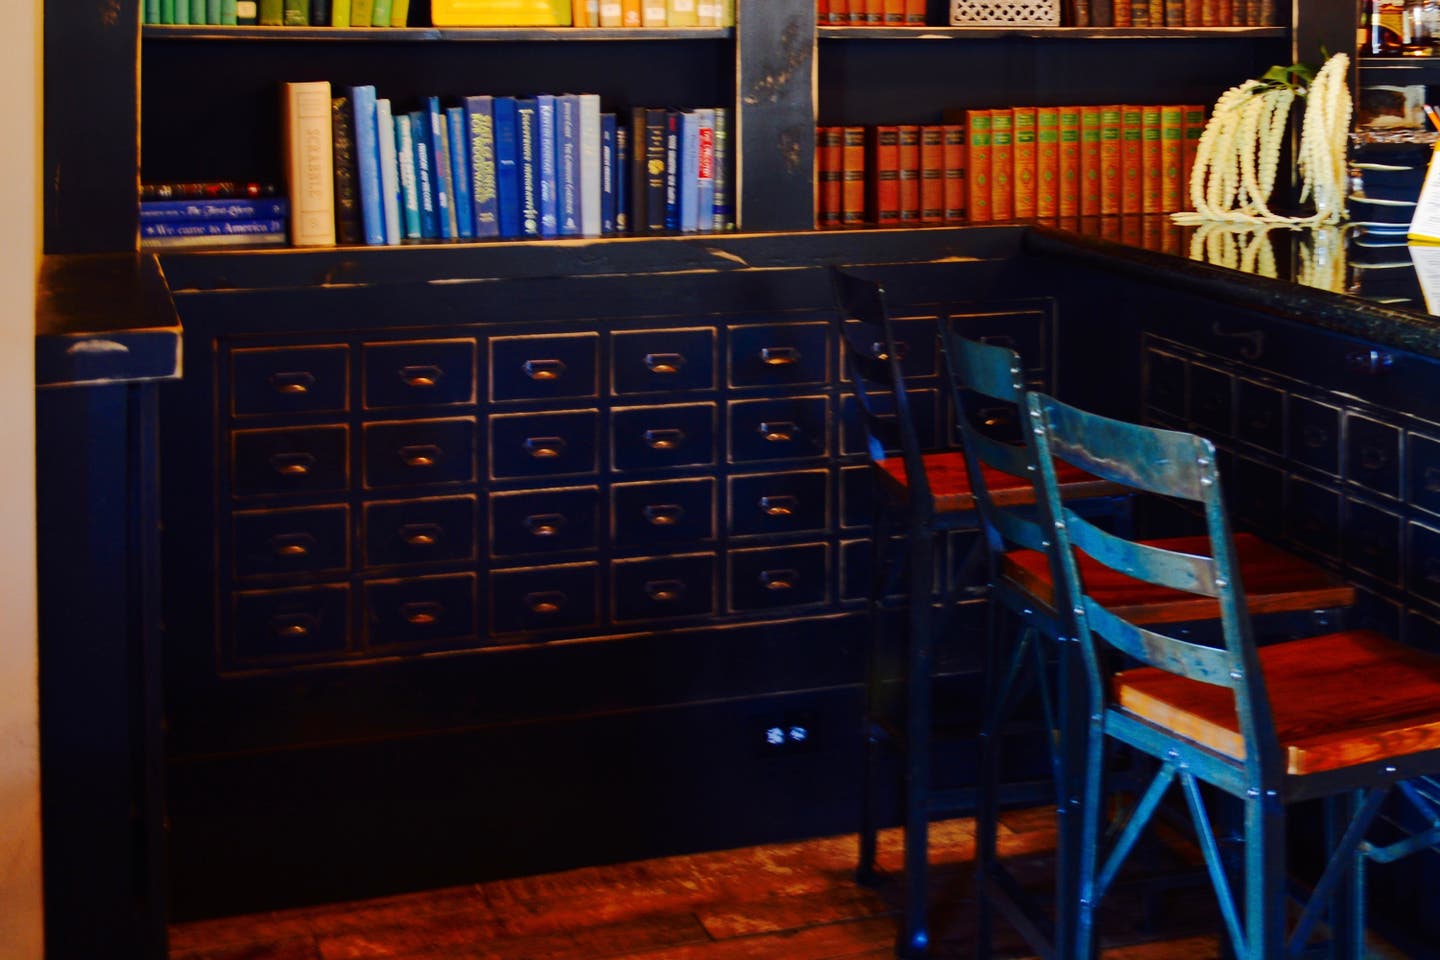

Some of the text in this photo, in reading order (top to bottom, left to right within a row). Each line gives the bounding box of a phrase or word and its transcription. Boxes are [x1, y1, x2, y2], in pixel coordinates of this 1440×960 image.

[472, 137, 487, 203] WOODWARD
[178, 225, 205, 235] came
[208, 224, 221, 234] to
[224, 222, 267, 234] America
